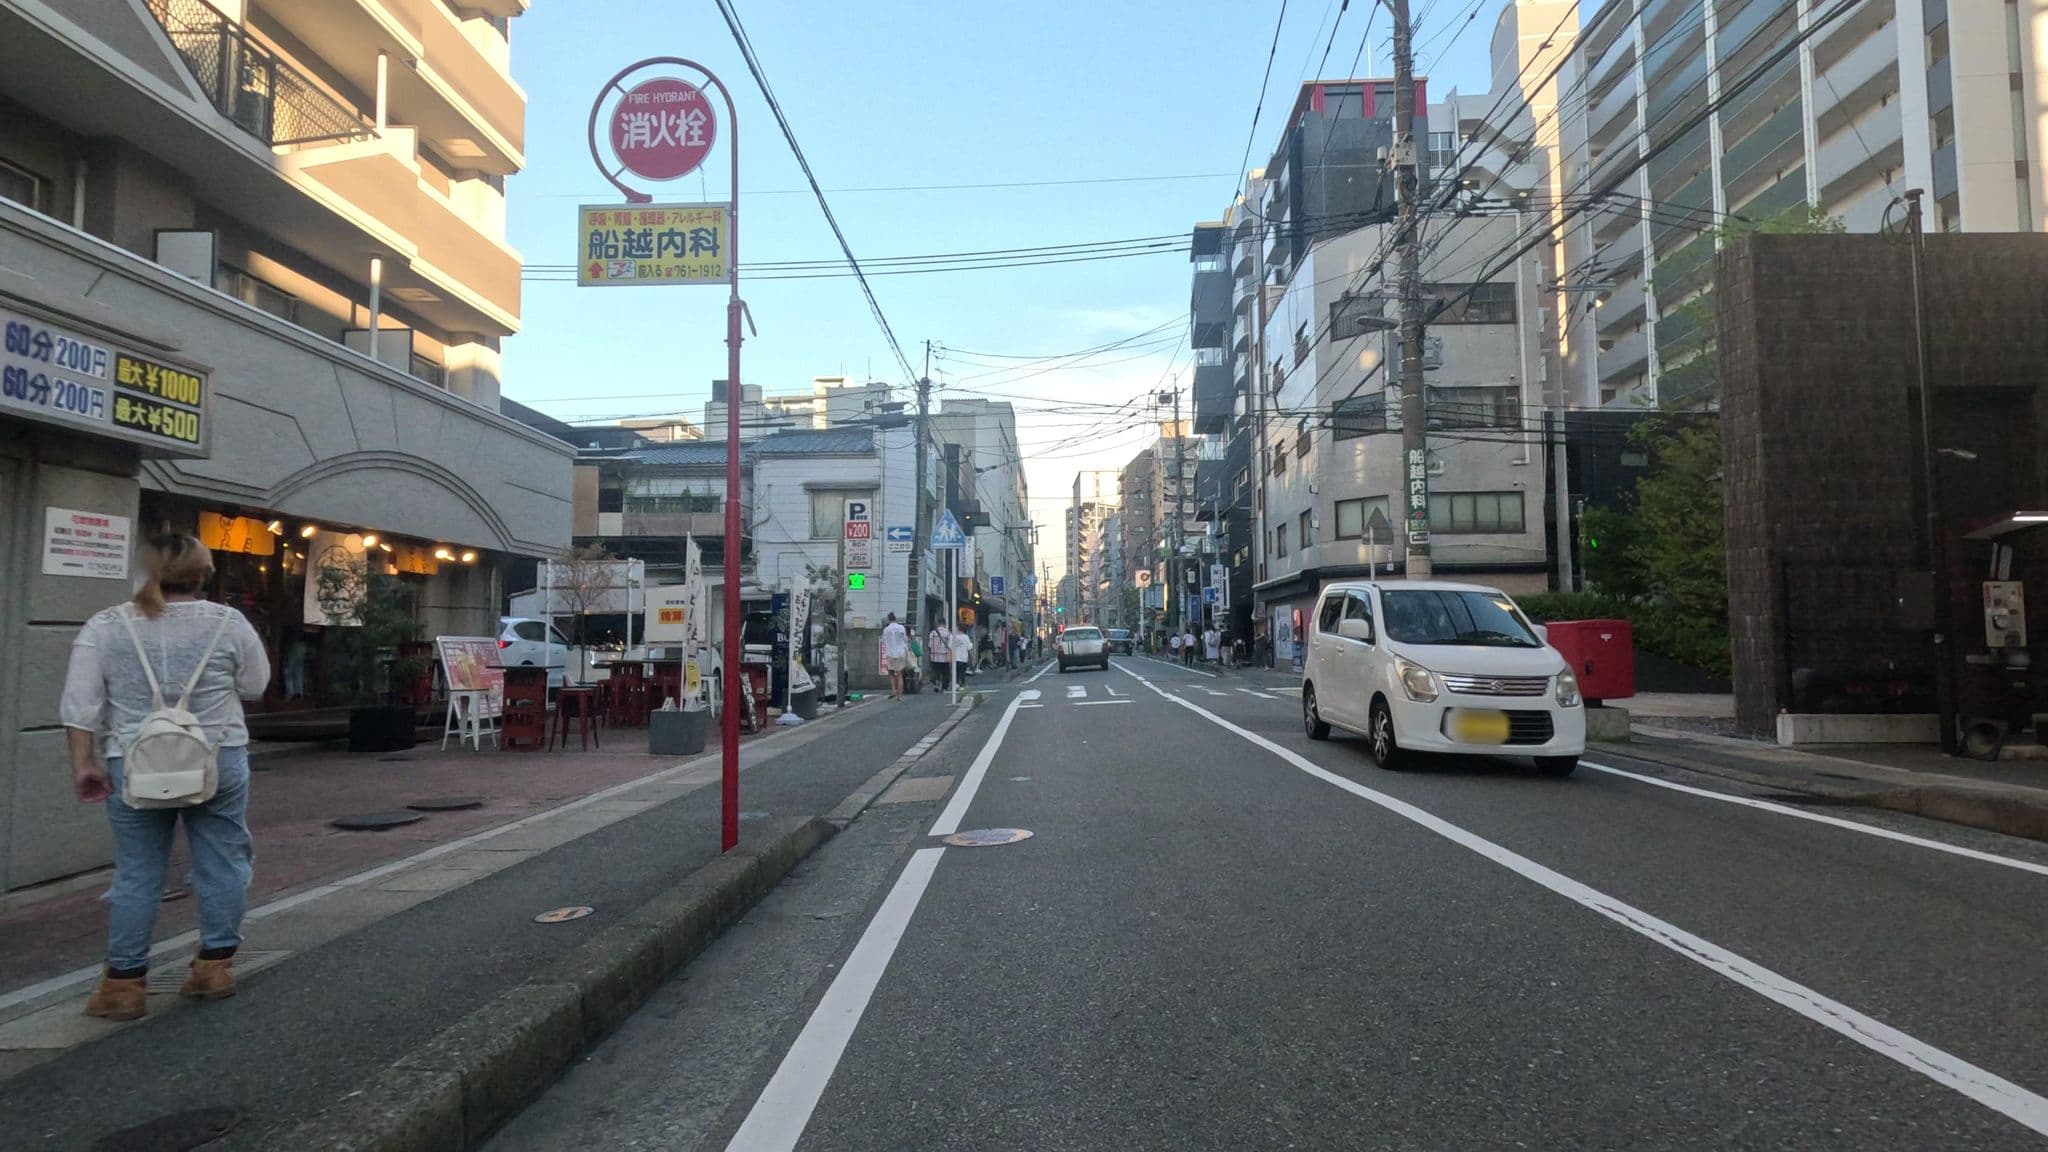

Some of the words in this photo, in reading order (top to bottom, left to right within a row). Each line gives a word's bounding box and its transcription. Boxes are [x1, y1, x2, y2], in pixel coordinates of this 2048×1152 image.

[628, 93, 649, 104] FIRE
[653, 91, 697, 103] HYDRANT
[621, 107, 706, 149] 消火栓
[588, 227, 720, 259] 船越内科
[674, 264, 721, 278] 761-1912
[1409, 449, 1426, 509] 船越内科
[849, 503, 866, 520] P
